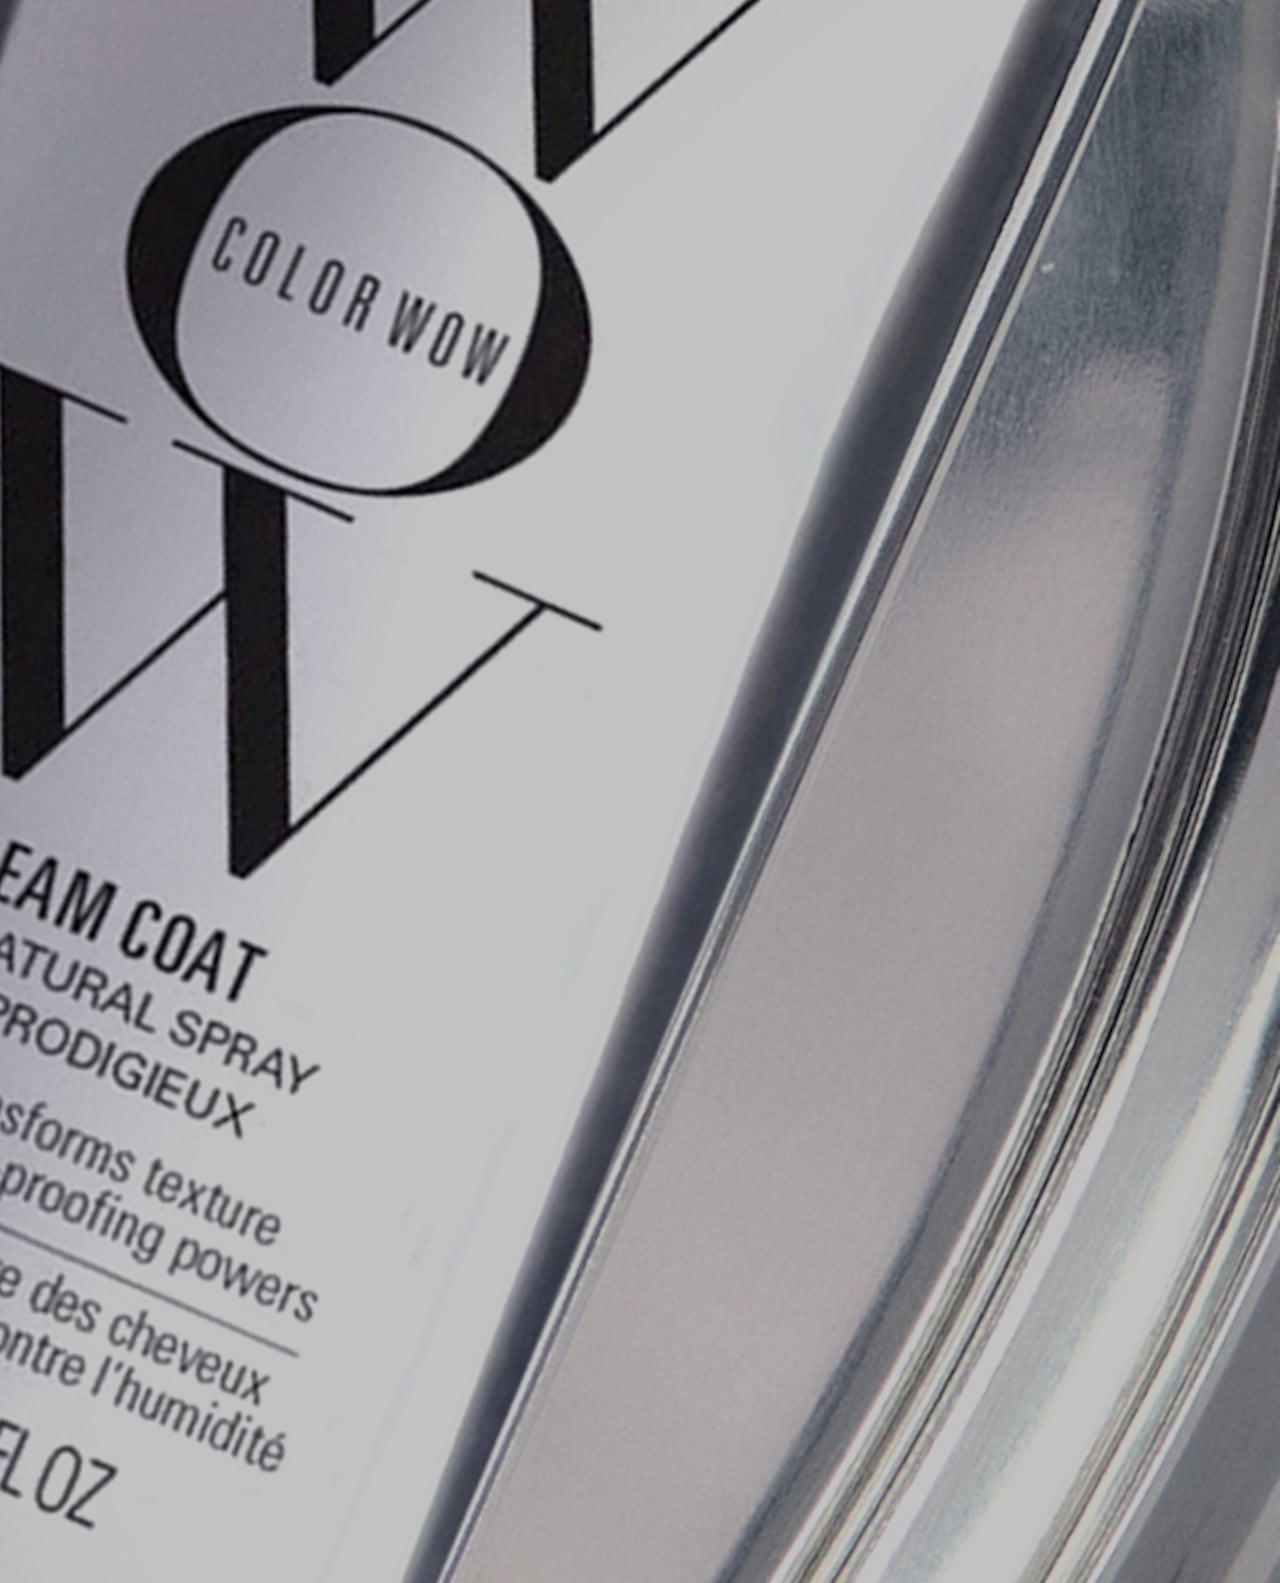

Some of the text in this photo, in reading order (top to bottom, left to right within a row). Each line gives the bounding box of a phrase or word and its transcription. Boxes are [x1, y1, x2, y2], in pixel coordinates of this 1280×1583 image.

[212, 217, 510, 386] COLOR WOW
[119, 899, 268, 1003] COAT
[168, 1009, 321, 1095] SPRAY
[142, 1158, 281, 1246] texture
[167, 1236, 319, 1323] powers
[28, 1273, 102, 1334] des
[107, 1309, 271, 1407] cheveux
[90, 1356, 286, 1473] l'humidité
